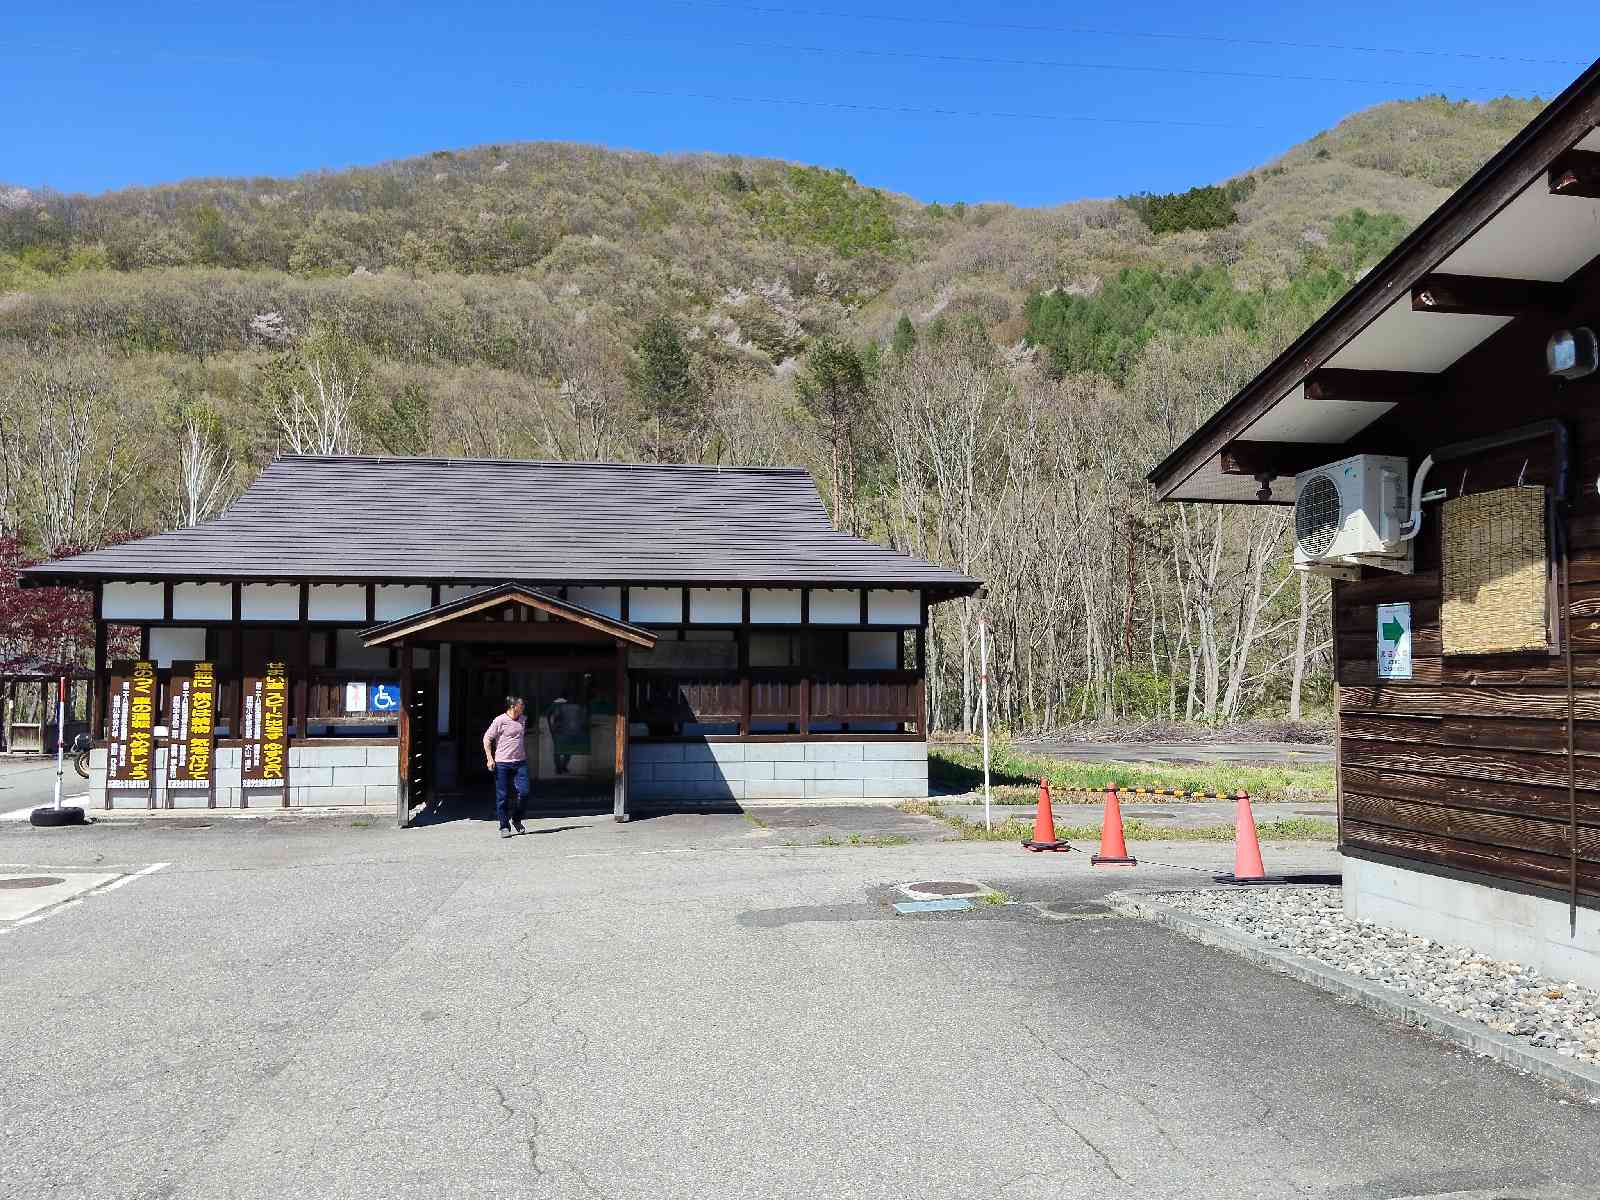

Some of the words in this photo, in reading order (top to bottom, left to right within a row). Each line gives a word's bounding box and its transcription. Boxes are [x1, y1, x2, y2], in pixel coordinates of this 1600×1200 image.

[192, 663, 214, 688] 運転に
[129, 732, 152, 780] やめましょう
